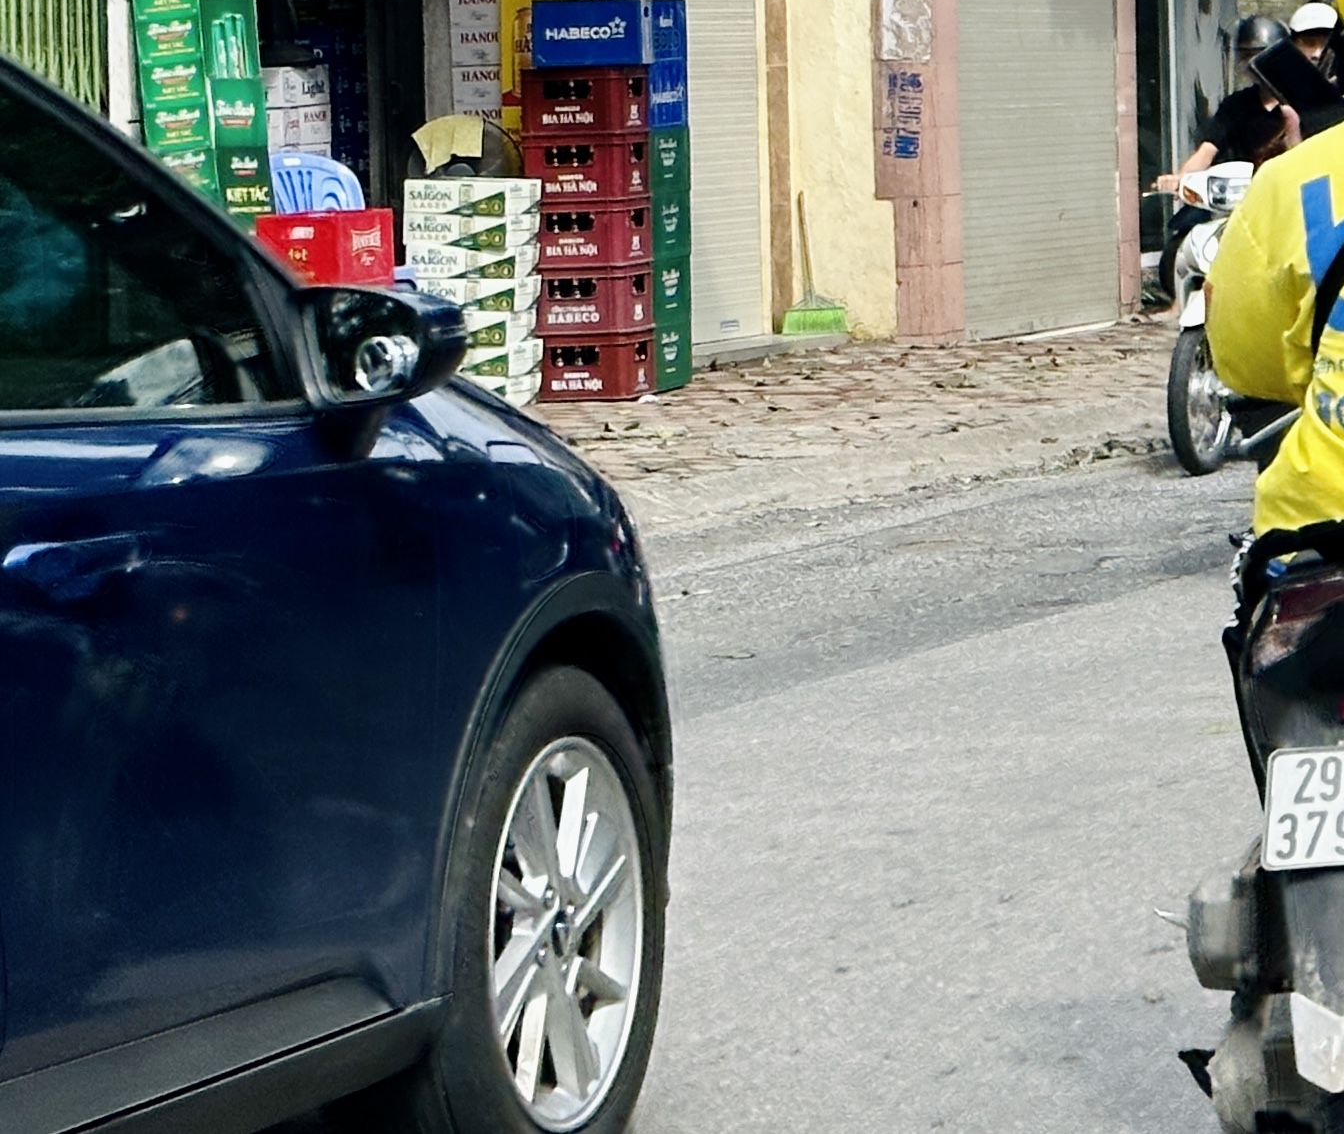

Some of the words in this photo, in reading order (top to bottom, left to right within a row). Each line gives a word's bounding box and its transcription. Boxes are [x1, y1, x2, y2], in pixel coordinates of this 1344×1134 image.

[545, 26, 611, 40] HABECO
[302, 79, 325, 98] Light
[248, 185, 270, 203] TÁC
